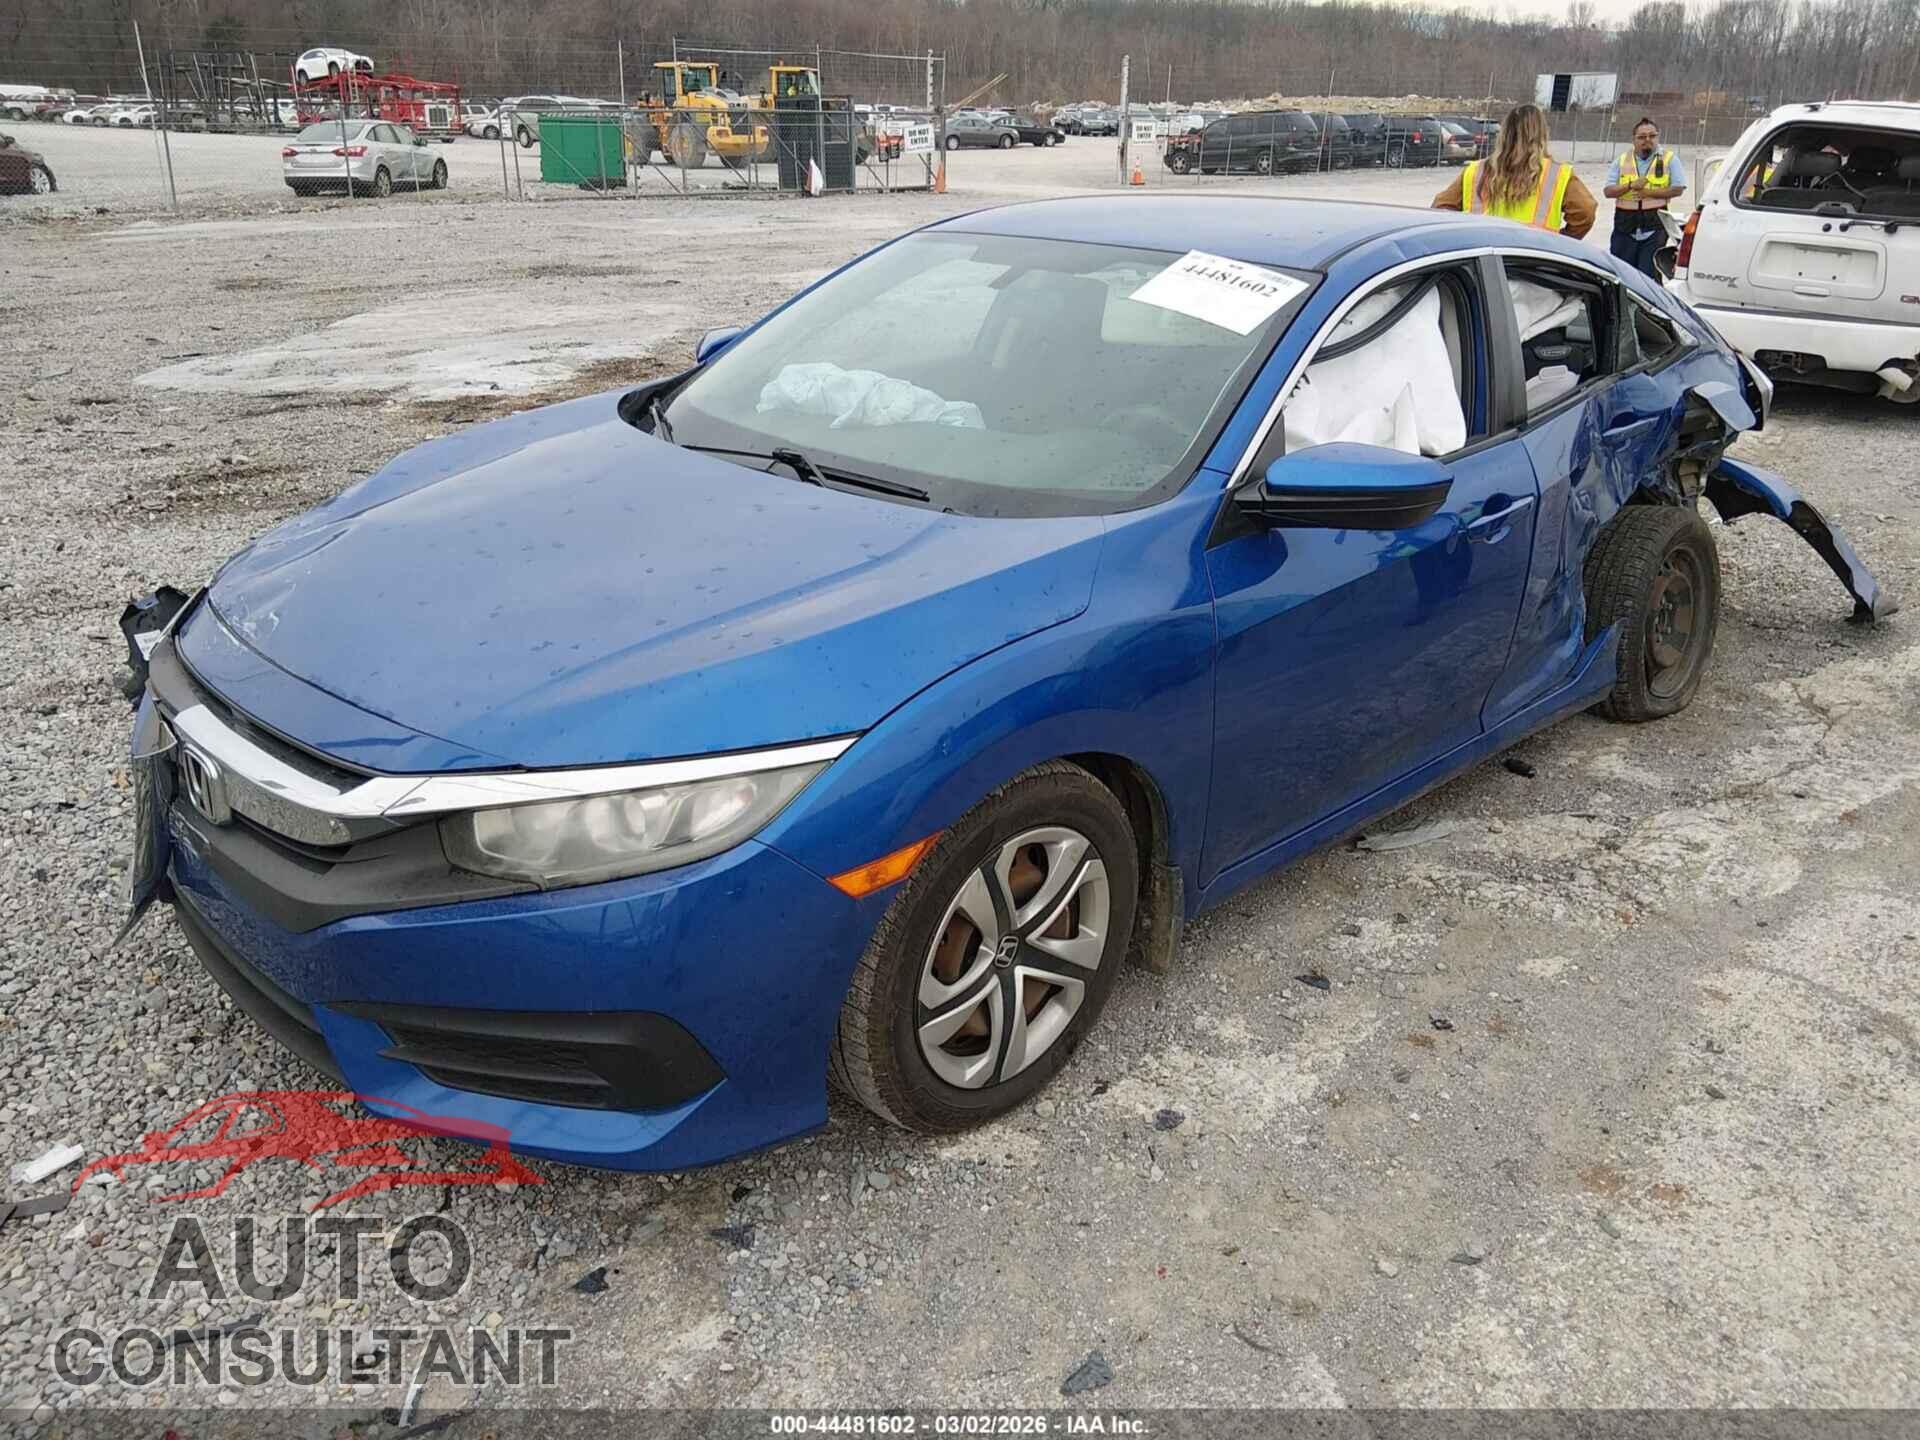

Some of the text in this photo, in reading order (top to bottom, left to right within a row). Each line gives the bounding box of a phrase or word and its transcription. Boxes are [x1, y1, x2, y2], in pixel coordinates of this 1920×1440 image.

[908, 127, 929, 137] DO NOT
[910, 136, 929, 145] ENTER
[1183, 264, 1278, 297] 44481602
